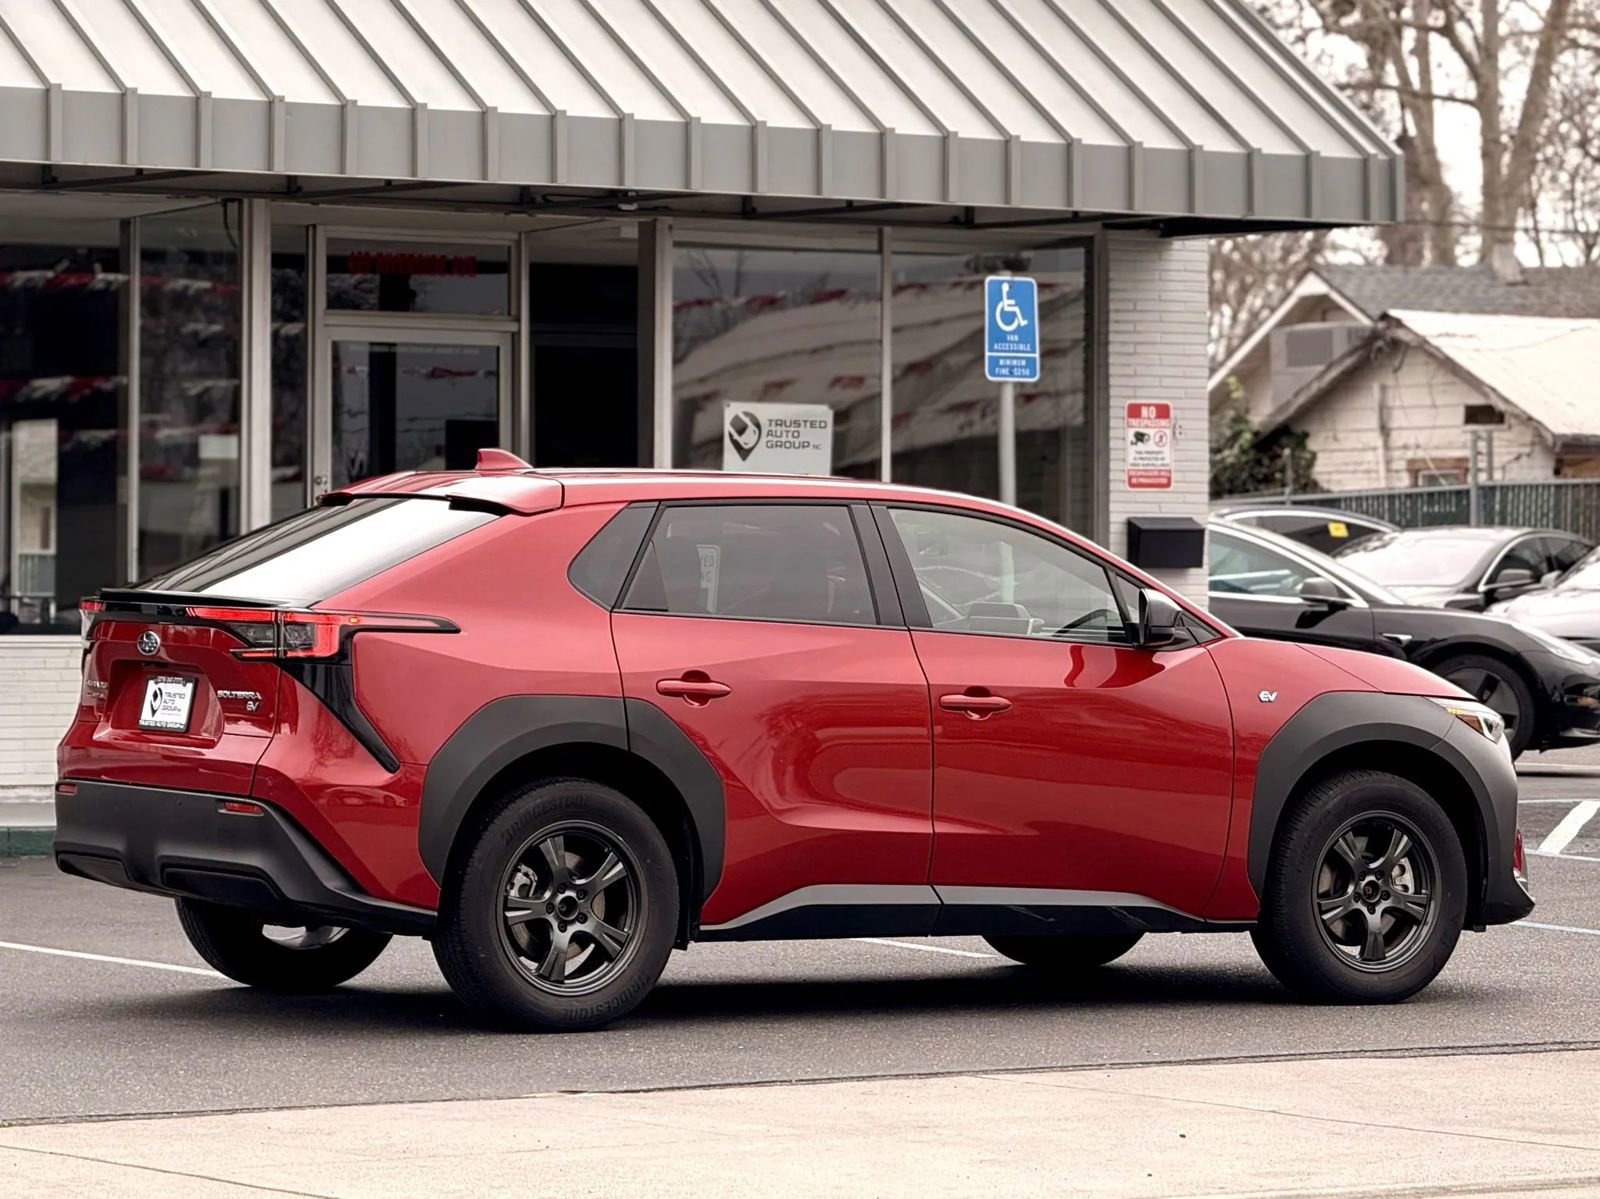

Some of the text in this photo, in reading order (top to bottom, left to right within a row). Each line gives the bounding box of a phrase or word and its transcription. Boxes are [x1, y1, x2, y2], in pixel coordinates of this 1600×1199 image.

[993, 342, 1032, 351] ACCESSIBLE
[995, 367, 1009, 375] FINE
[1140, 405, 1157, 419] NO
[767, 419, 828, 429] TRUSTED
[765, 429, 801, 439] AUTO
[765, 440, 811, 450] GROUP
[164, 691, 186, 700] TRUSTED
[216, 690, 262, 700] SOLTERRA
[1258, 690, 1278, 702] EV
[246, 701, 260, 712] EV
